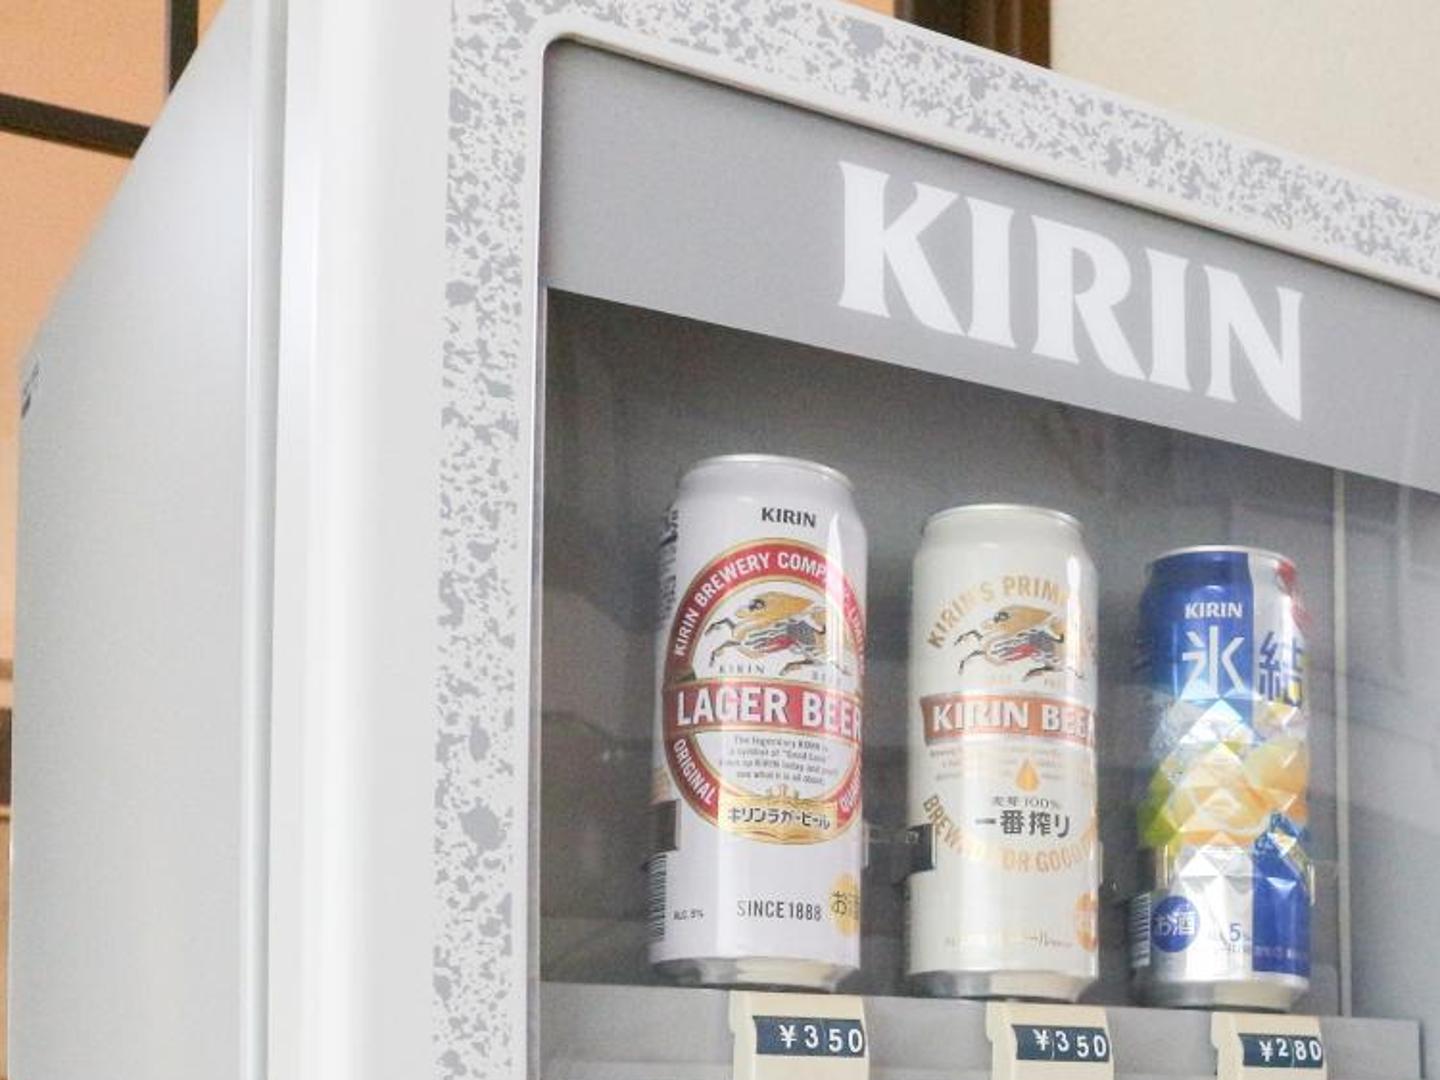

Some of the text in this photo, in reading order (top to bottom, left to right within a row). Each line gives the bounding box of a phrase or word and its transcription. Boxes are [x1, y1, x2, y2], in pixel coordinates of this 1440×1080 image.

[838, 160, 1303, 422] KIRIN
[761, 506, 816, 528] KIRIN
[674, 604, 700, 656] KIRIN
[693, 551, 770, 608] BREWERY
[1184, 601, 1243, 619] KIRIN
[677, 686, 862, 738] LAGER BEER
[932, 700, 1030, 733] KIRIN
[673, 738, 717, 806] ORIGINAL
[974, 810, 1070, 838] 一番搾り
[736, 899, 822, 922] SINCE 1888
[779, 1023, 863, 1054] ¥350
[1034, 1029, 1107, 1058] ¥350
[1259, 1037, 1322, 1062] ¥280
